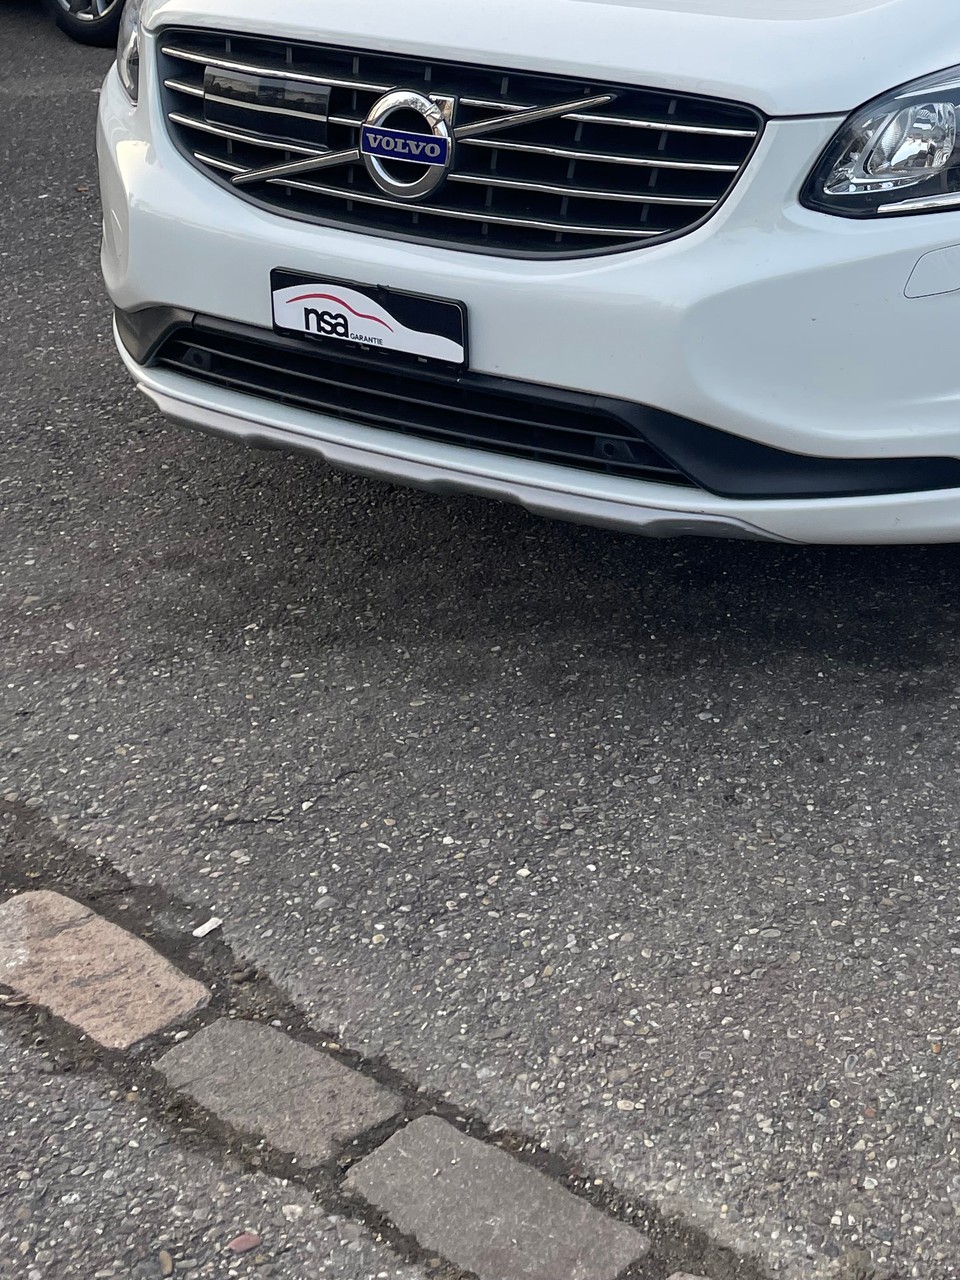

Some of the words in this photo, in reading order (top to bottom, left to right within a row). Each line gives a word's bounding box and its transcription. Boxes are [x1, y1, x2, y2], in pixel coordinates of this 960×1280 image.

[366, 133, 440, 157] VOLVO
[304, 307, 349, 338] nsa
[350, 332, 383, 345] GARANTIE
